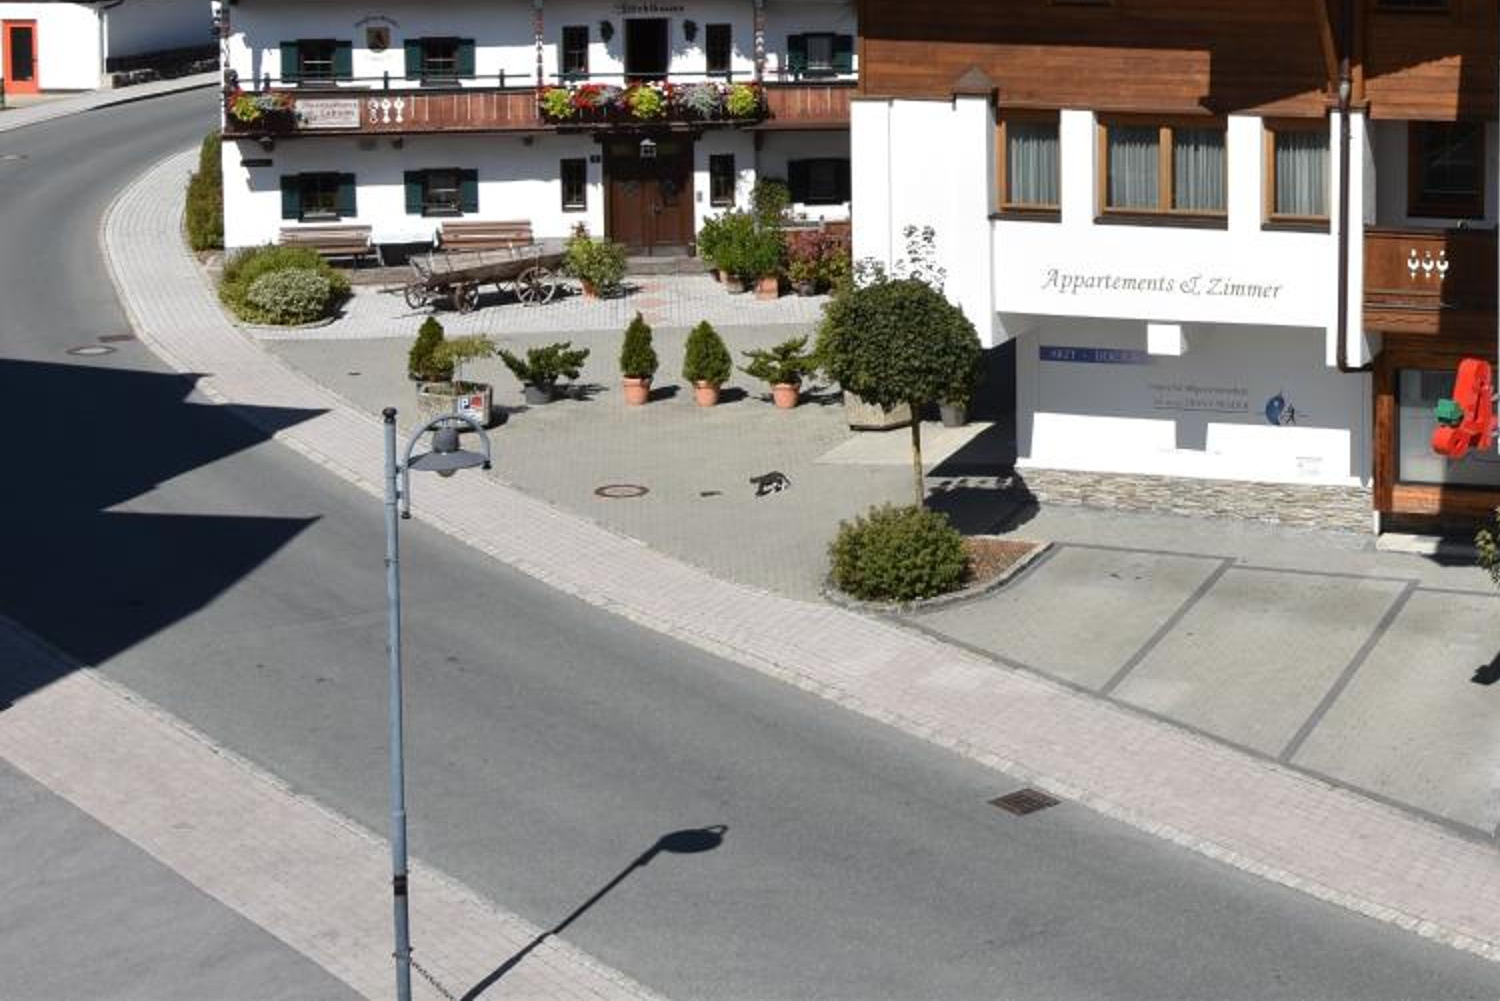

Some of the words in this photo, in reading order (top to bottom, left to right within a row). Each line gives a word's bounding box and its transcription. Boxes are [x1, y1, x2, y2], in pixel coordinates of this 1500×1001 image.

[1040, 267, 1175, 295] Appartements
[1179, 274, 1202, 296] &
[1206, 277, 1284, 299] Zimmer
